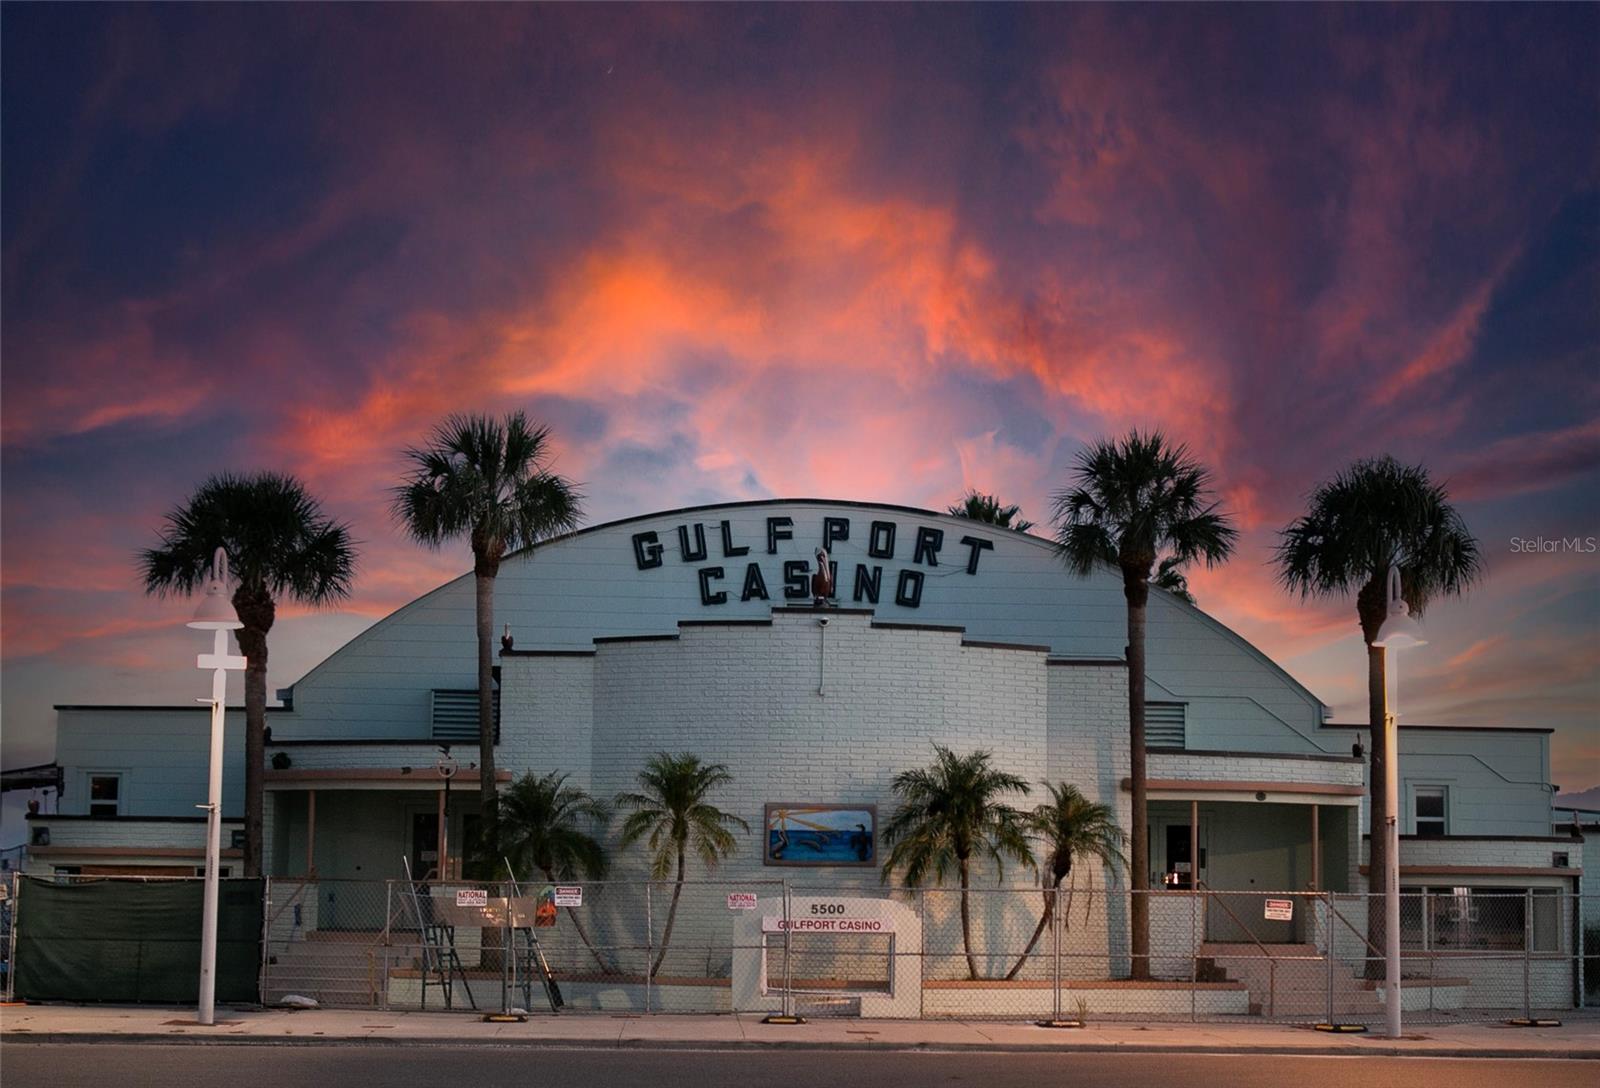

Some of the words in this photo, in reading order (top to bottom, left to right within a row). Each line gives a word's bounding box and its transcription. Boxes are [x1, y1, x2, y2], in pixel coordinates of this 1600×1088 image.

[632, 516, 994, 575] GULFPORT
[699, 560, 925, 608] CASINO
[811, 904, 845, 914] 5500
[778, 920, 836, 930] GULFPORT
[839, 920, 881, 930] CASINO
